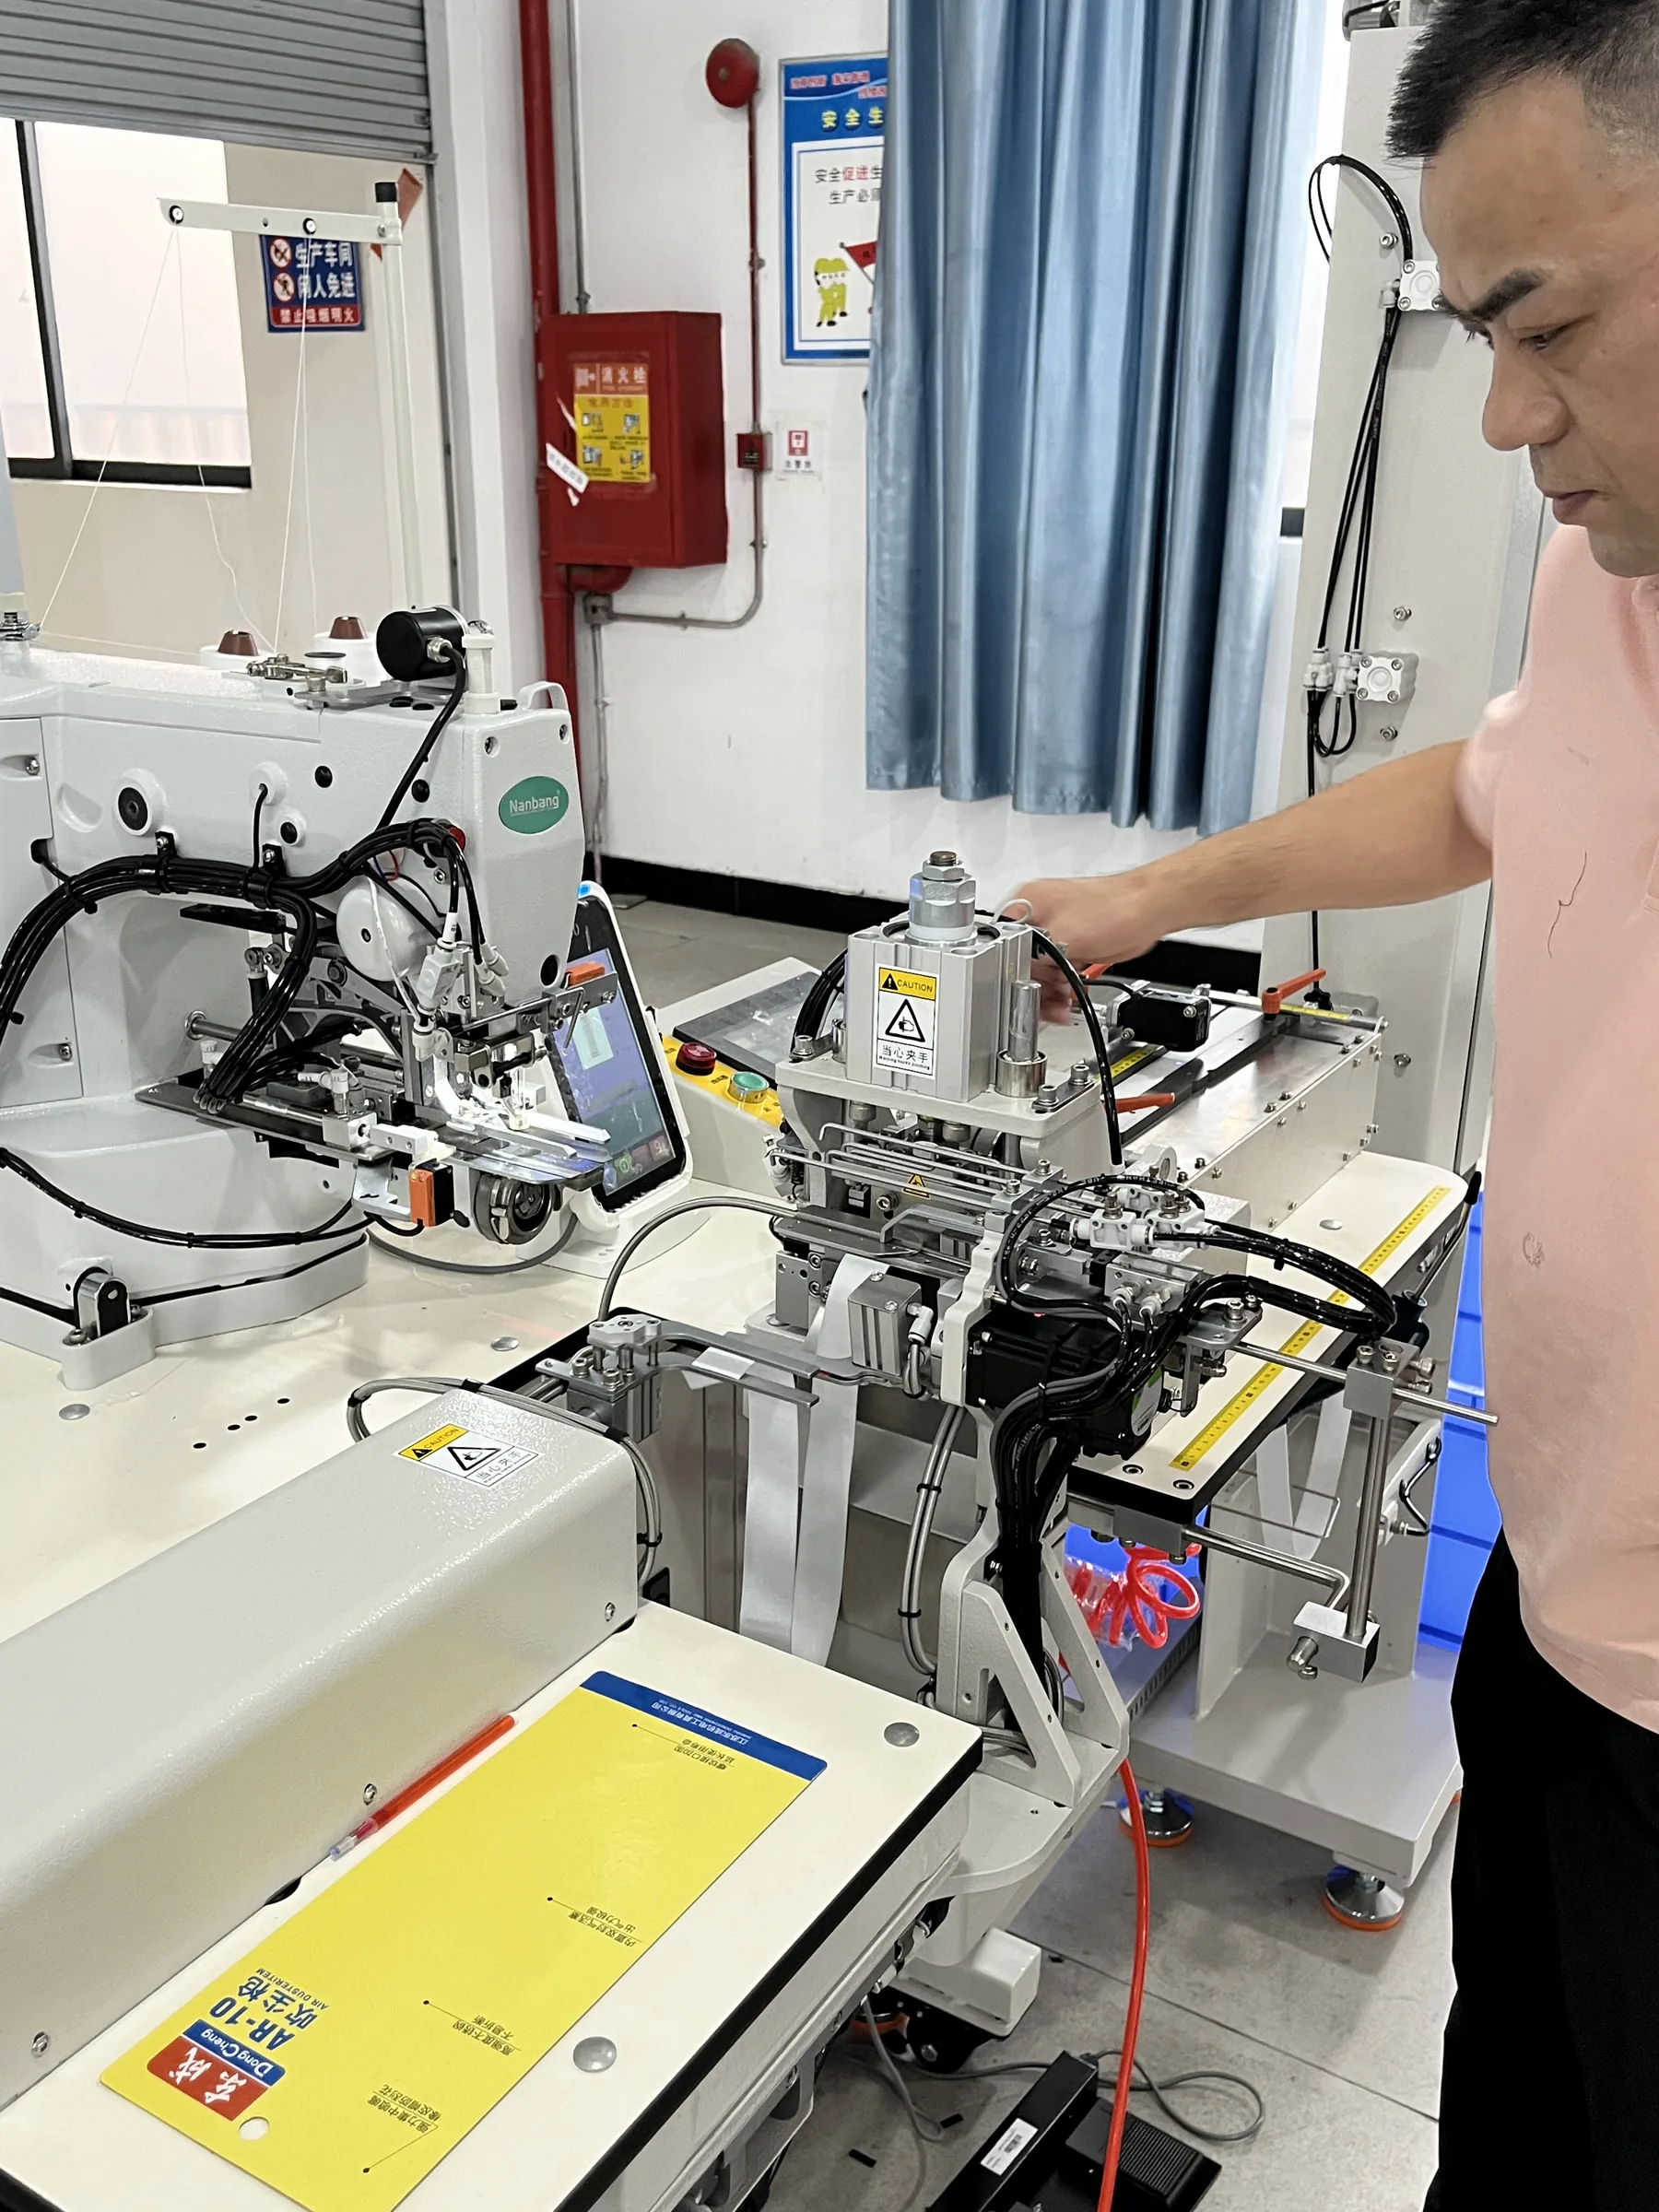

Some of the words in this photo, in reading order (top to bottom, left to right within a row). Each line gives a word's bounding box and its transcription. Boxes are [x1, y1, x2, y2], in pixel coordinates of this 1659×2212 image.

[295, 241, 353, 268] 生产车间
[509, 795, 559, 814] Nanbang
[897, 979, 933, 993] CAUTION
[882, 1044, 929, 1064] 当心夹手
[424, 1429, 459, 1449] CAUTION
[477, 1451, 522, 1478] 当心夹手
[651, 1701, 750, 1746] 江苏东成机电工具有限公司
[674, 1744, 726, 1770] 螺纹接口加固
[682, 1738, 735, 1764] 延长使用寿命
[255, 1968, 312, 2002] DUSTERITEM
[238, 1975, 319, 2030] 吹尘枪
[311, 1998, 330, 2011] AIR
[208, 1996, 296, 2052] AR-10
[452, 2018, 515, 2056] 高强度不锈钢
[471, 2015, 514, 2041] 不易折断
[169, 2046, 248, 2104] 东成
[367, 2095, 432, 2134] 强力集中喷嘴
[378, 2084, 442, 2122] 橡皮帽防刮花
